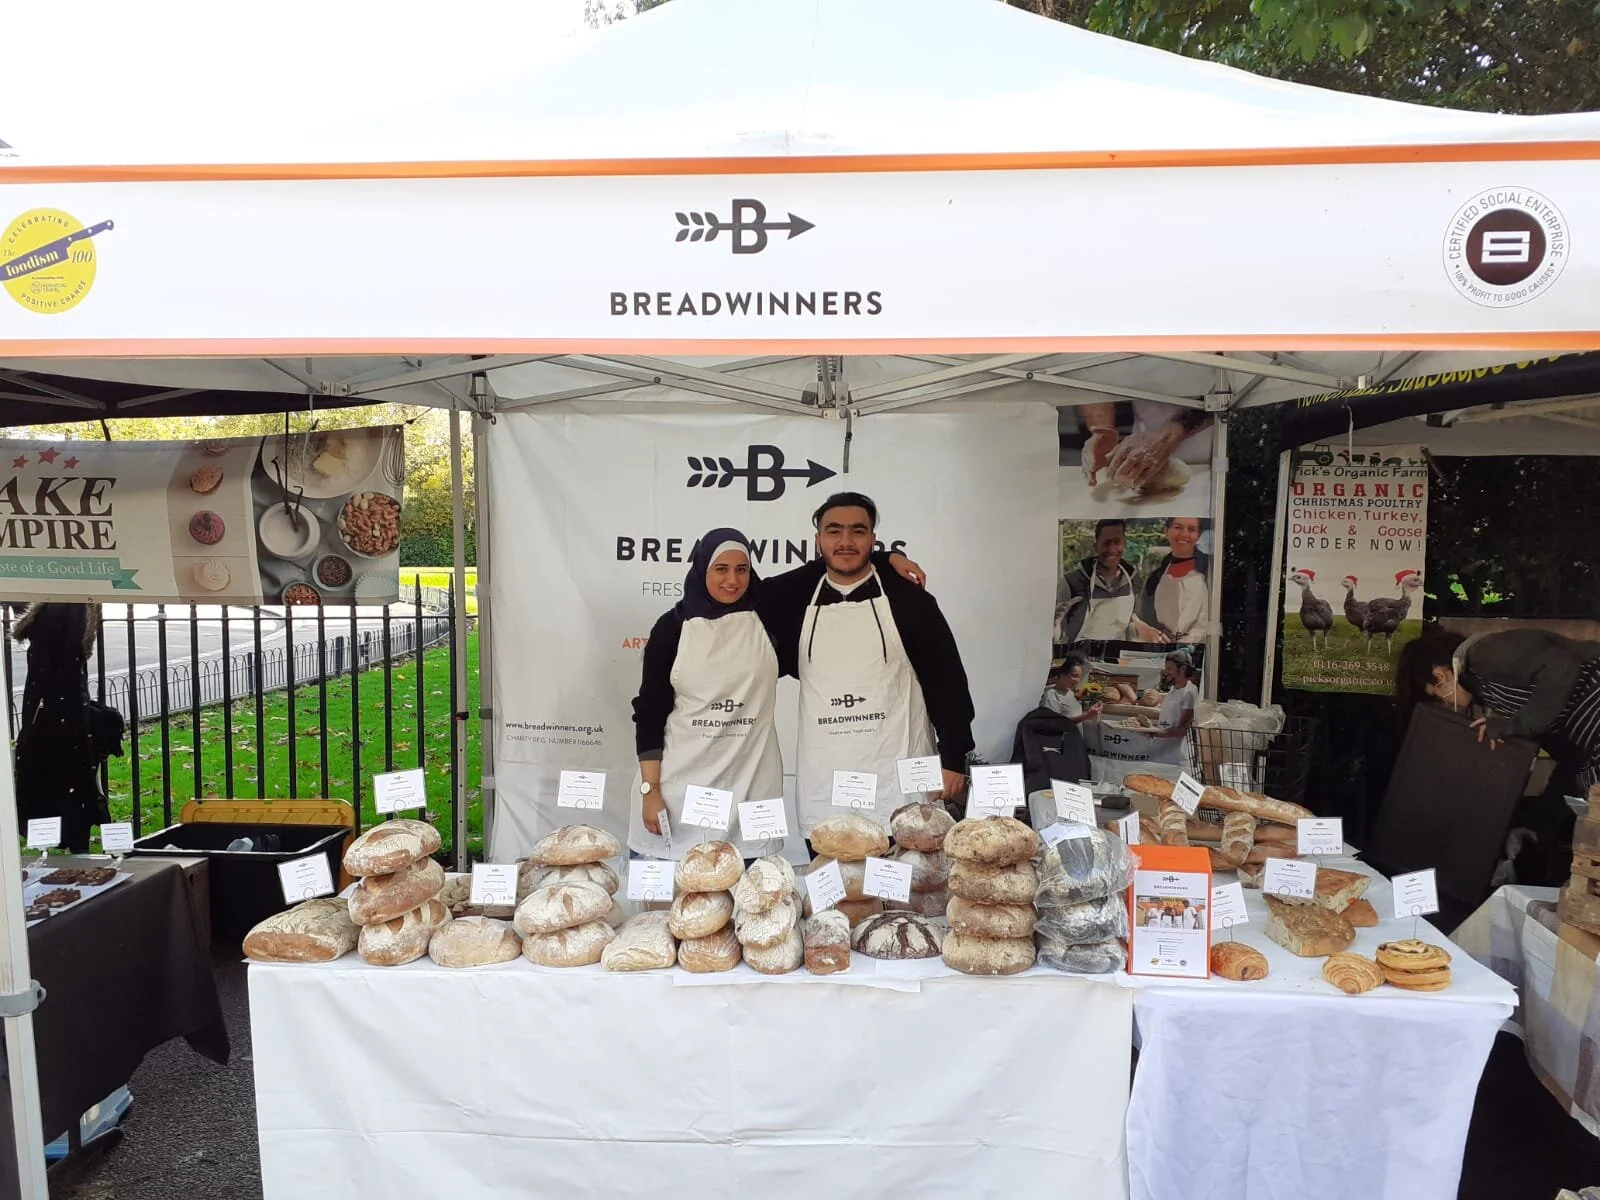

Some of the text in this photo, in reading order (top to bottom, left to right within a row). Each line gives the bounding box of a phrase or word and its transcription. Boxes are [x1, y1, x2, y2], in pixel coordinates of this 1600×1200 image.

[8, 215, 70, 243] CELEBRATING
[1448, 191, 1564, 260] CERTIFIED SOCIAL ENTERPRISE
[3, 249, 16, 257] The
[71, 250, 93, 263] 100
[5, 250, 60, 277] foodism
[1466, 285, 1491, 301] PROFIT
[1493, 294, 1503, 302] TO
[1504, 289, 1527, 302] GOOD
[1527, 267, 1555, 293] CAUSES
[21, 292, 57, 308] POSITIVE
[60, 279, 87, 305] CHANGE
[610, 291, 883, 316] BREADWINNERS
[1334, 467, 1389, 479] Organic
[1392, 468, 1428, 477] Farm
[0, 476, 117, 516] AKE
[1292, 482, 1424, 497] ORGANIC
[1293, 499, 1422, 508] CHRISTMAS POULTRY
[0, 519, 117, 550] MPIRE
[1292, 523, 1423, 537] Duck & Goose
[1293, 537, 1421, 551] ORDER NOW!
[0, 560, 18, 572] ste
[20, 560, 36, 572] of
[47, 561, 84, 574] Good
[88, 562, 115, 575] Life
[642, 582, 682, 597] FRES
[622, 637, 650, 649] ART
[817, 712, 886, 725] BREADWINNERS
[505, 721, 604, 736] www.breadwinners.org.uk
